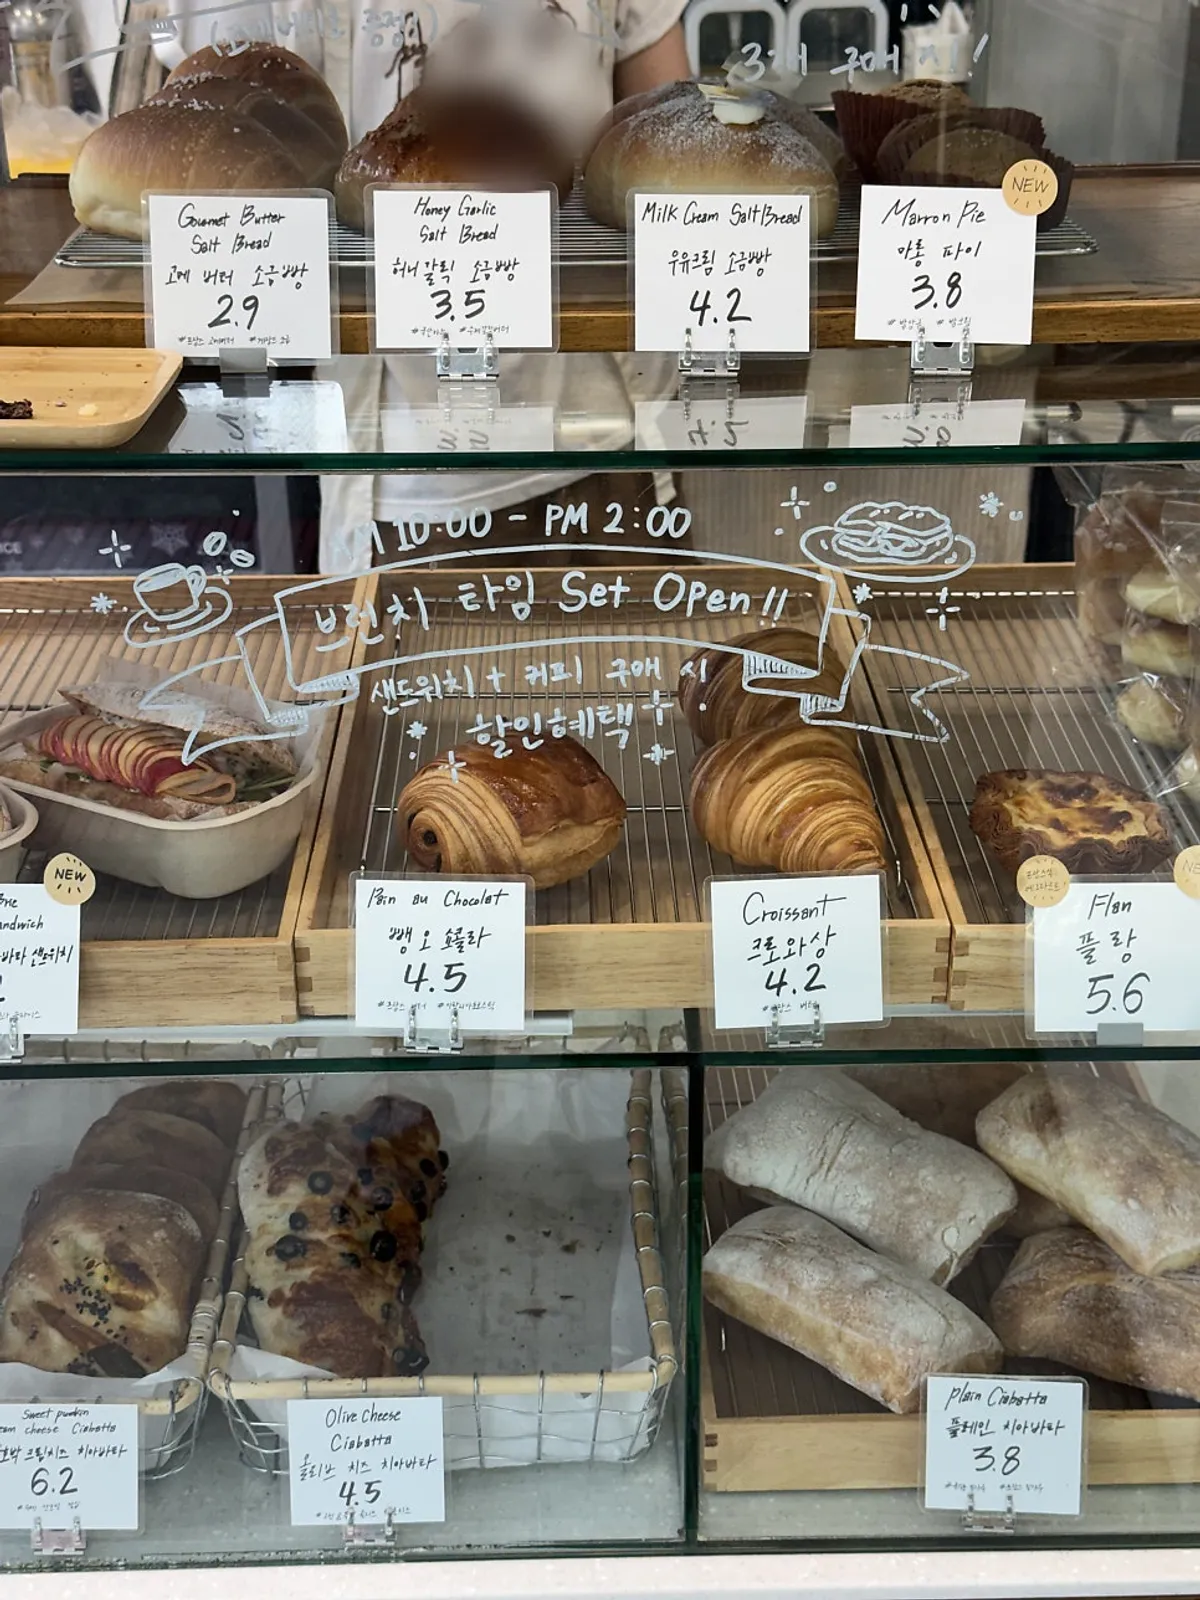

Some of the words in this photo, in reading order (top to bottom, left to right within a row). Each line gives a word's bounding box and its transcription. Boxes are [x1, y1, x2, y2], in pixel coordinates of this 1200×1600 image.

[1012, 176, 1050, 194] NEW
[240, 204, 286, 227] Butter
[414, 196, 451, 222] Honey
[458, 194, 497, 217] Garlic
[641, 202, 679, 222] Milk
[683, 200, 719, 226] Cream
[729, 202, 761, 227] Salt
[760, 203, 803, 227] Bread
[881, 198, 951, 227] Marron
[956, 199, 987, 229] Pie
[190, 234, 221, 255] Salt
[231, 232, 272, 254] Bread
[419, 224, 447, 244] Salt
[459, 224, 499, 245] Bread
[668, 249, 715, 276] 우유크림
[724, 247, 772, 277] 소금빵
[897, 238, 925, 268] 마롱
[942, 241, 982, 261] 파이
[165, 265, 190, 286] 고메
[203, 269, 234, 286] 버터
[252, 263, 309, 290] 소금빵
[469, 257, 520, 284] 소금빵
[430, 289, 486, 322] 3.5
[911, 271, 963, 311] 3.8
[207, 294, 260, 331] 2.9
[689, 288, 752, 327] 4.2
[392, 505, 492, 551] 10:00
[545, 502, 589, 537] PM
[602, 502, 692, 538] 2:00
[314, 584, 430, 653] 브런치
[457, 569, 535, 622] 타임
[558, 570, 631, 613] Set
[370, 664, 475, 716] 샌드위치
[524, 655, 583, 687] 커피
[605, 656, 662, 688] 구매
[680, 658, 708, 683] 시
[465, 702, 635, 759] 할인혜택
[54, 867, 87, 884] NEW
[367, 886, 397, 908] Pain
[412, 893, 429, 905] au
[443, 888, 509, 908] Chocolat
[742, 891, 847, 926] Croissant
[1087, 891, 1133, 920] Flan
[388, 926, 413, 955] 뺑
[418, 930, 432, 952] 오
[440, 926, 492, 954] 쇼콜라
[746, 925, 837, 967] 크로와상
[1075, 927, 1137, 966] 플랑
[403, 962, 467, 993] 4.5
[764, 963, 827, 997] 4.2
[1085, 972, 1151, 1015] 5.6
[22, 1408, 53, 1421] Sweet
[325, 1405, 358, 1428] Olive
[361, 1402, 402, 1424] Cheese
[946, 1416, 997, 1439] 플레인
[1003, 1418, 1066, 1436] 치아바타
[299, 1453, 337, 1482] 올리브
[347, 1459, 373, 1475] 치즈
[381, 1454, 438, 1472] 치아바타
[972, 1445, 1021, 1476] 3.8
[30, 1466, 79, 1496] 6.2
[339, 1479, 383, 1507] 4.5
